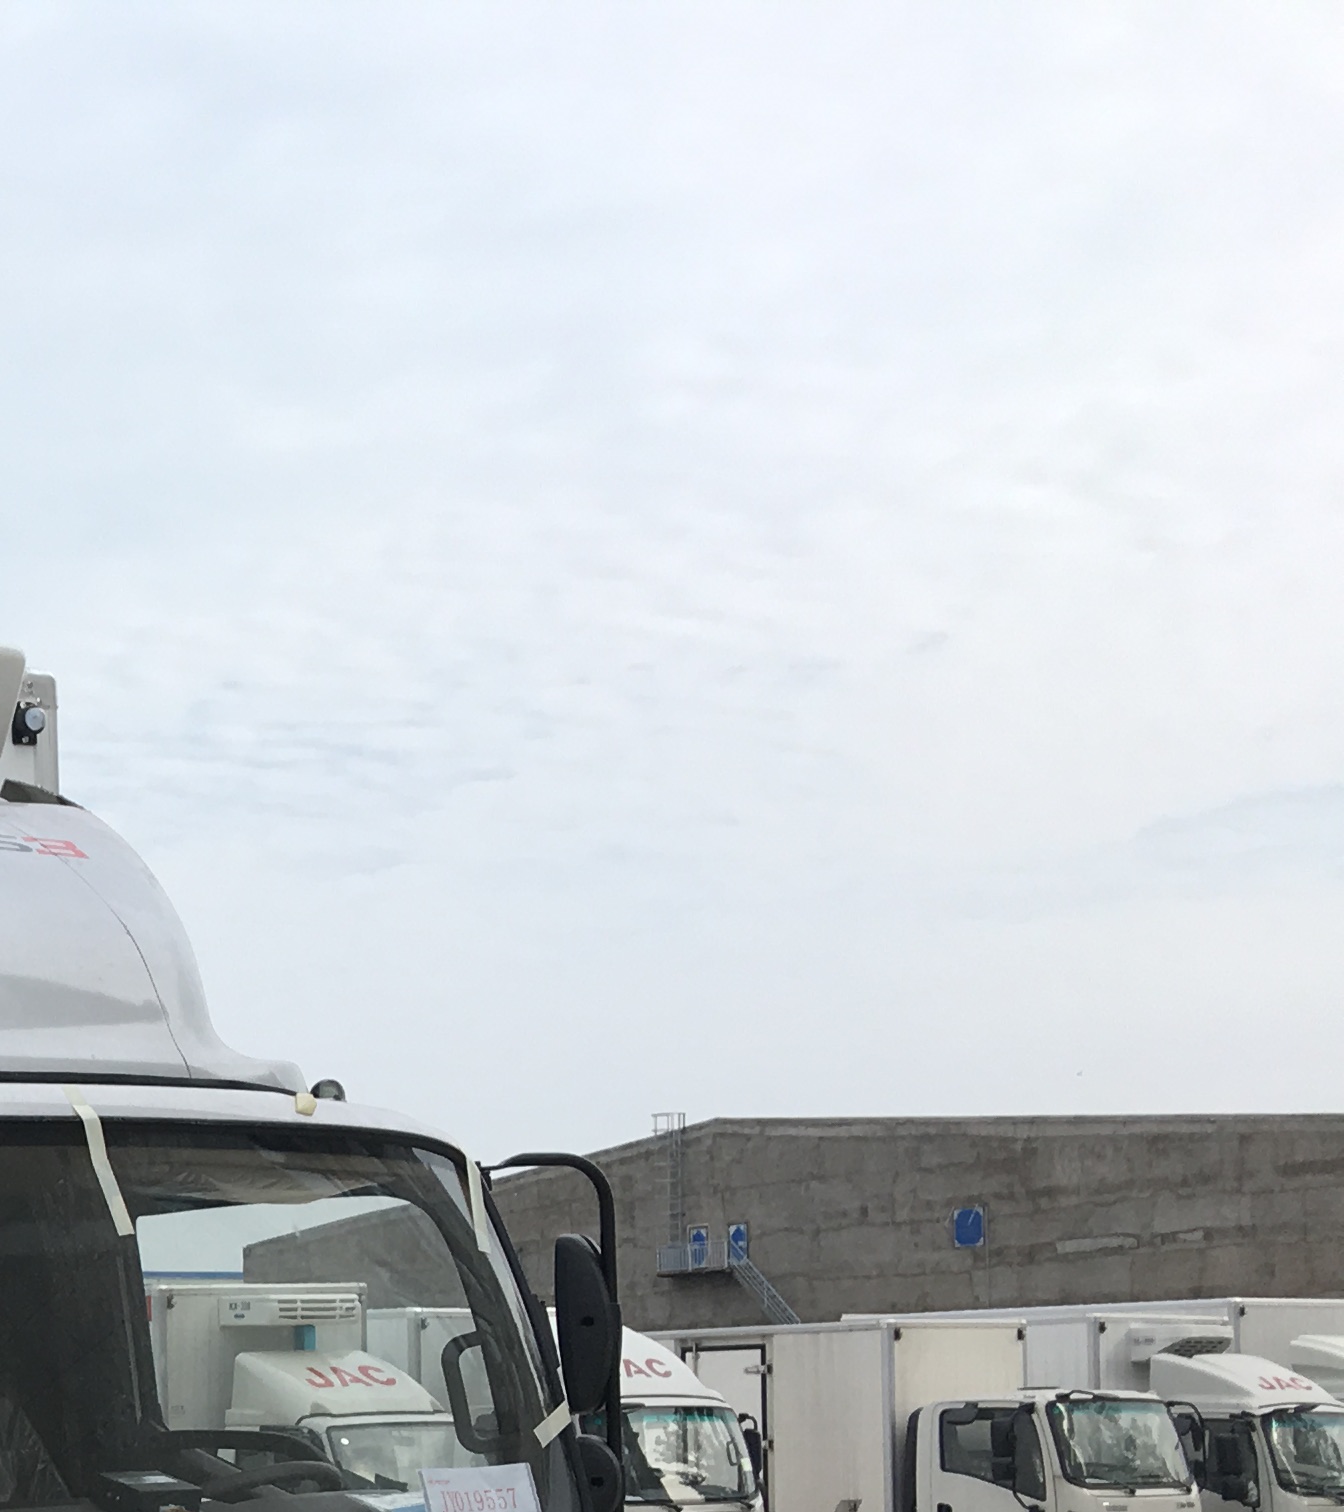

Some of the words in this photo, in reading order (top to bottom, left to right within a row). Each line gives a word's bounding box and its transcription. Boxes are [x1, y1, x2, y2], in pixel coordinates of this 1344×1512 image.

[305, 1365, 397, 1388] JAC
[622, 1358, 672, 1377] AC
[1258, 1376, 1312, 1390] JAC
